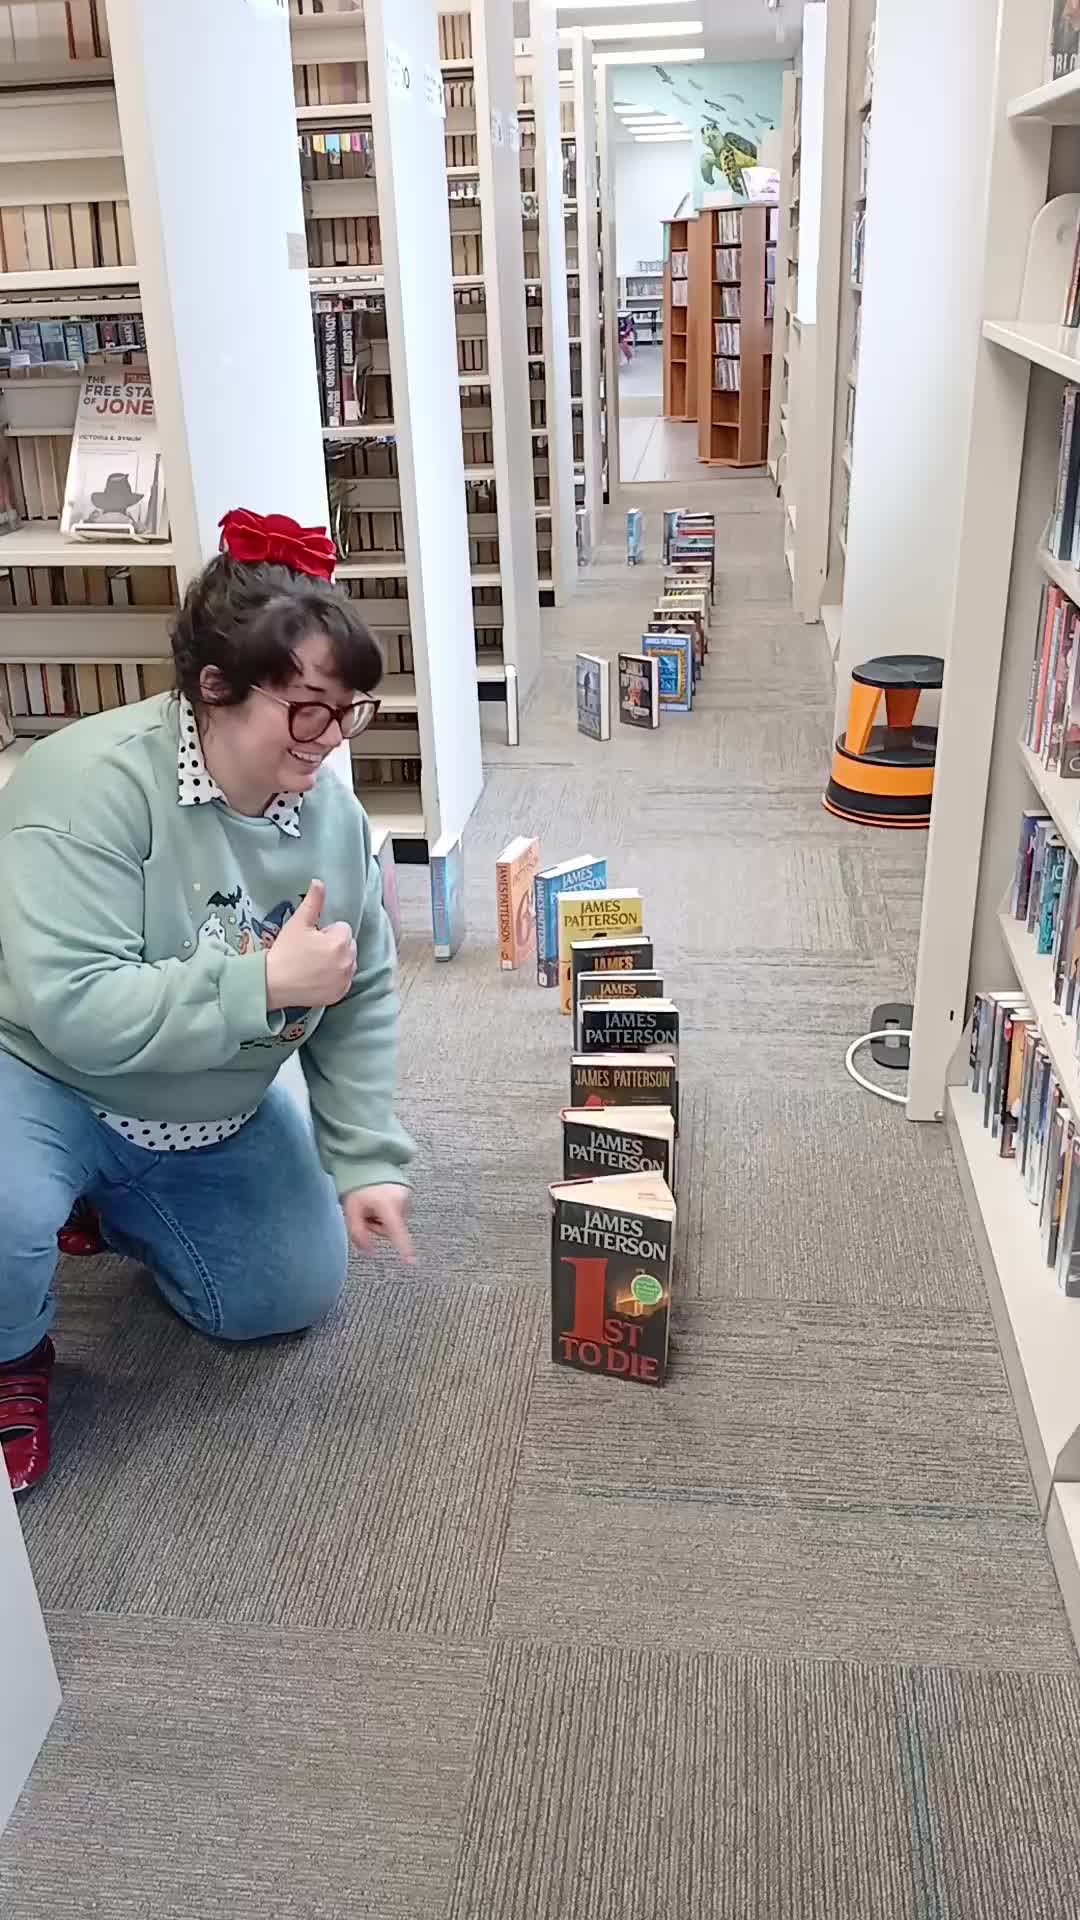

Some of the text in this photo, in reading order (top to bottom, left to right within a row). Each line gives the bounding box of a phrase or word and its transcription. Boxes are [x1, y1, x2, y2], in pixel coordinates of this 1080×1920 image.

[325, 314, 336, 388] JOHN SANDFORD
[87, 375, 106, 384] THE
[85, 384, 121, 397] FREE
[83, 397, 96, 405] OF
[499, 864, 509, 894] JAMES
[562, 867, 593, 890] JAMES
[581, 900, 621, 915] JAMES
[500, 895, 510, 943] PATTERSON
[564, 912, 638, 928] PATTERSON
[594, 955, 633, 970] JAMES
[600, 983, 637, 996] JAMES
[605, 1012, 657, 1029] JAMES
[584, 1028, 677, 1045] PATTERSON
[575, 1069, 670, 1088] JAMES PATTERSON
[589, 1131, 643, 1156] JAMES
[568, 1143, 665, 1172] PATTERSON
[583, 1209, 643, 1238] JAMES
[560, 1223, 667, 1262] PATTERSON
[559, 1335, 659, 1381] TO DIE
